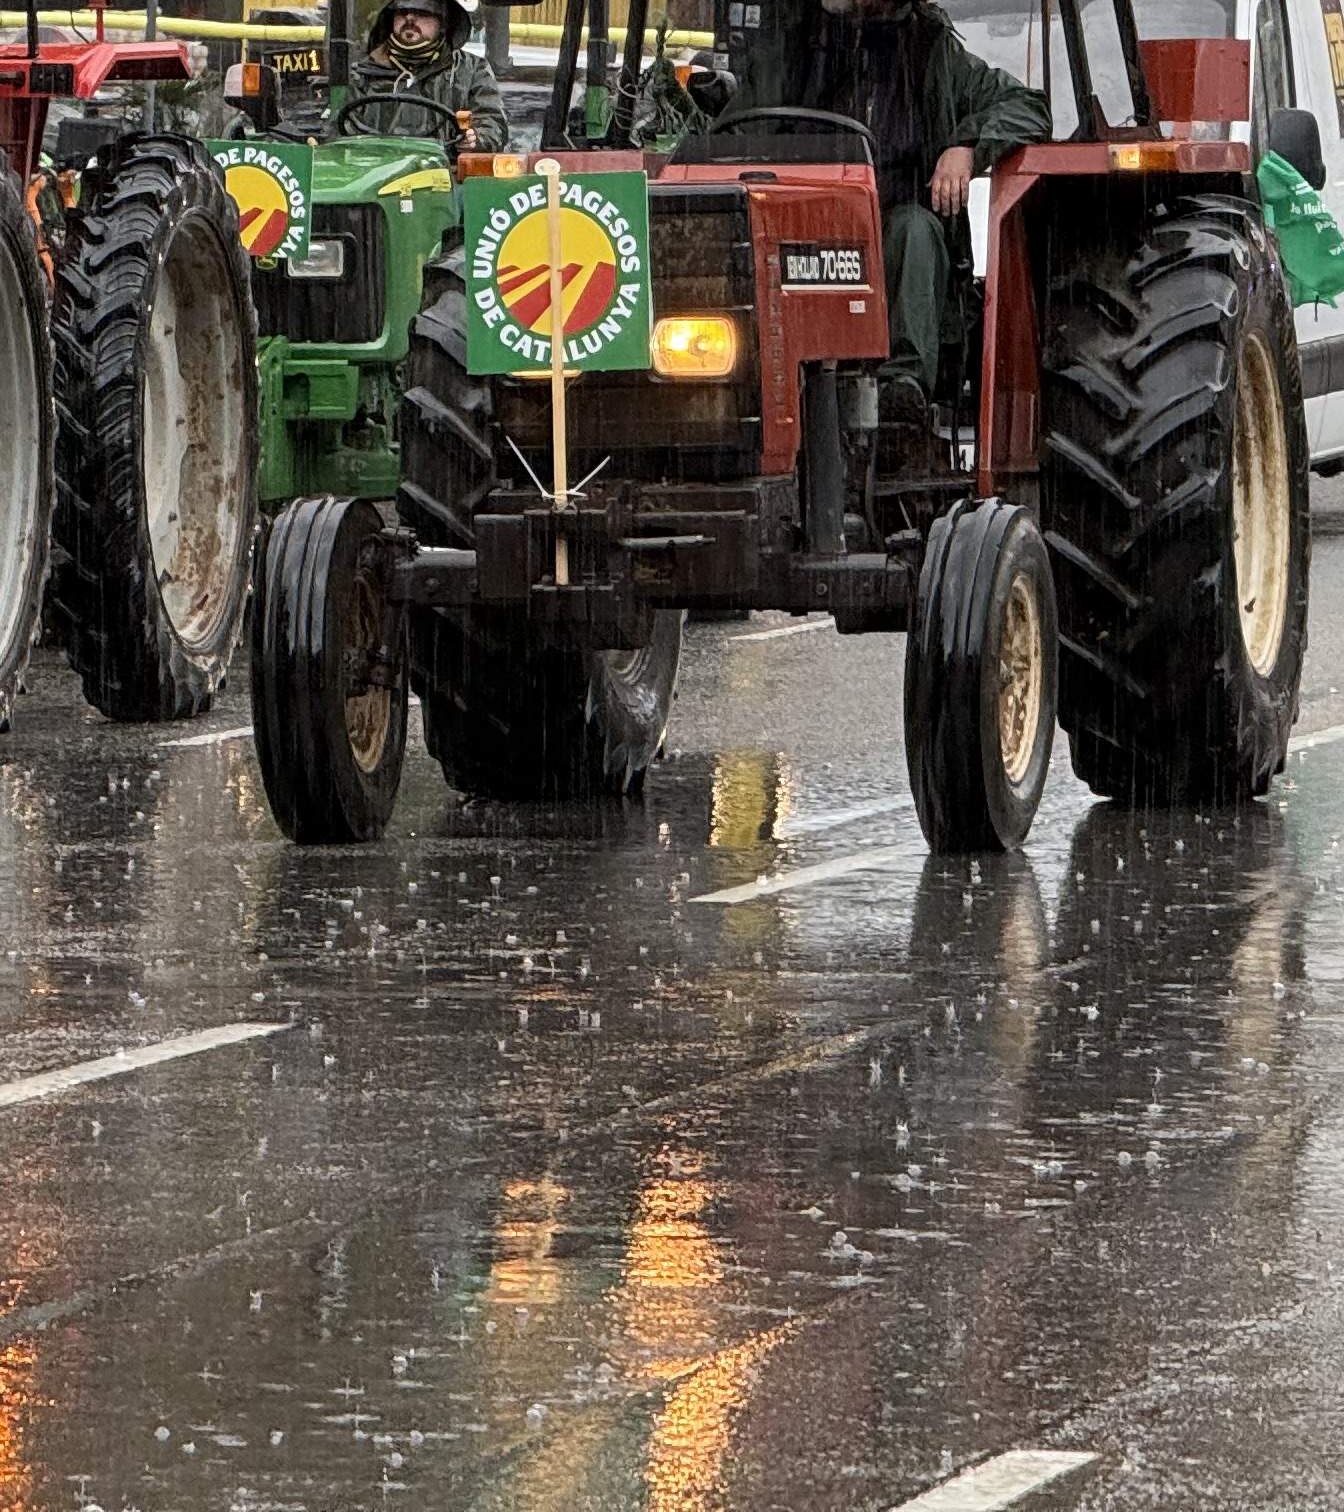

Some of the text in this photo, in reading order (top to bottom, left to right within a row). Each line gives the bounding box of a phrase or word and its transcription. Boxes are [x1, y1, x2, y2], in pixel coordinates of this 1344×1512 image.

[213, 146, 306, 219] DE PAGESOS
[473, 207, 511, 279] UNIÓ
[509, 183, 547, 216] DE
[474, 287, 506, 329] DE
